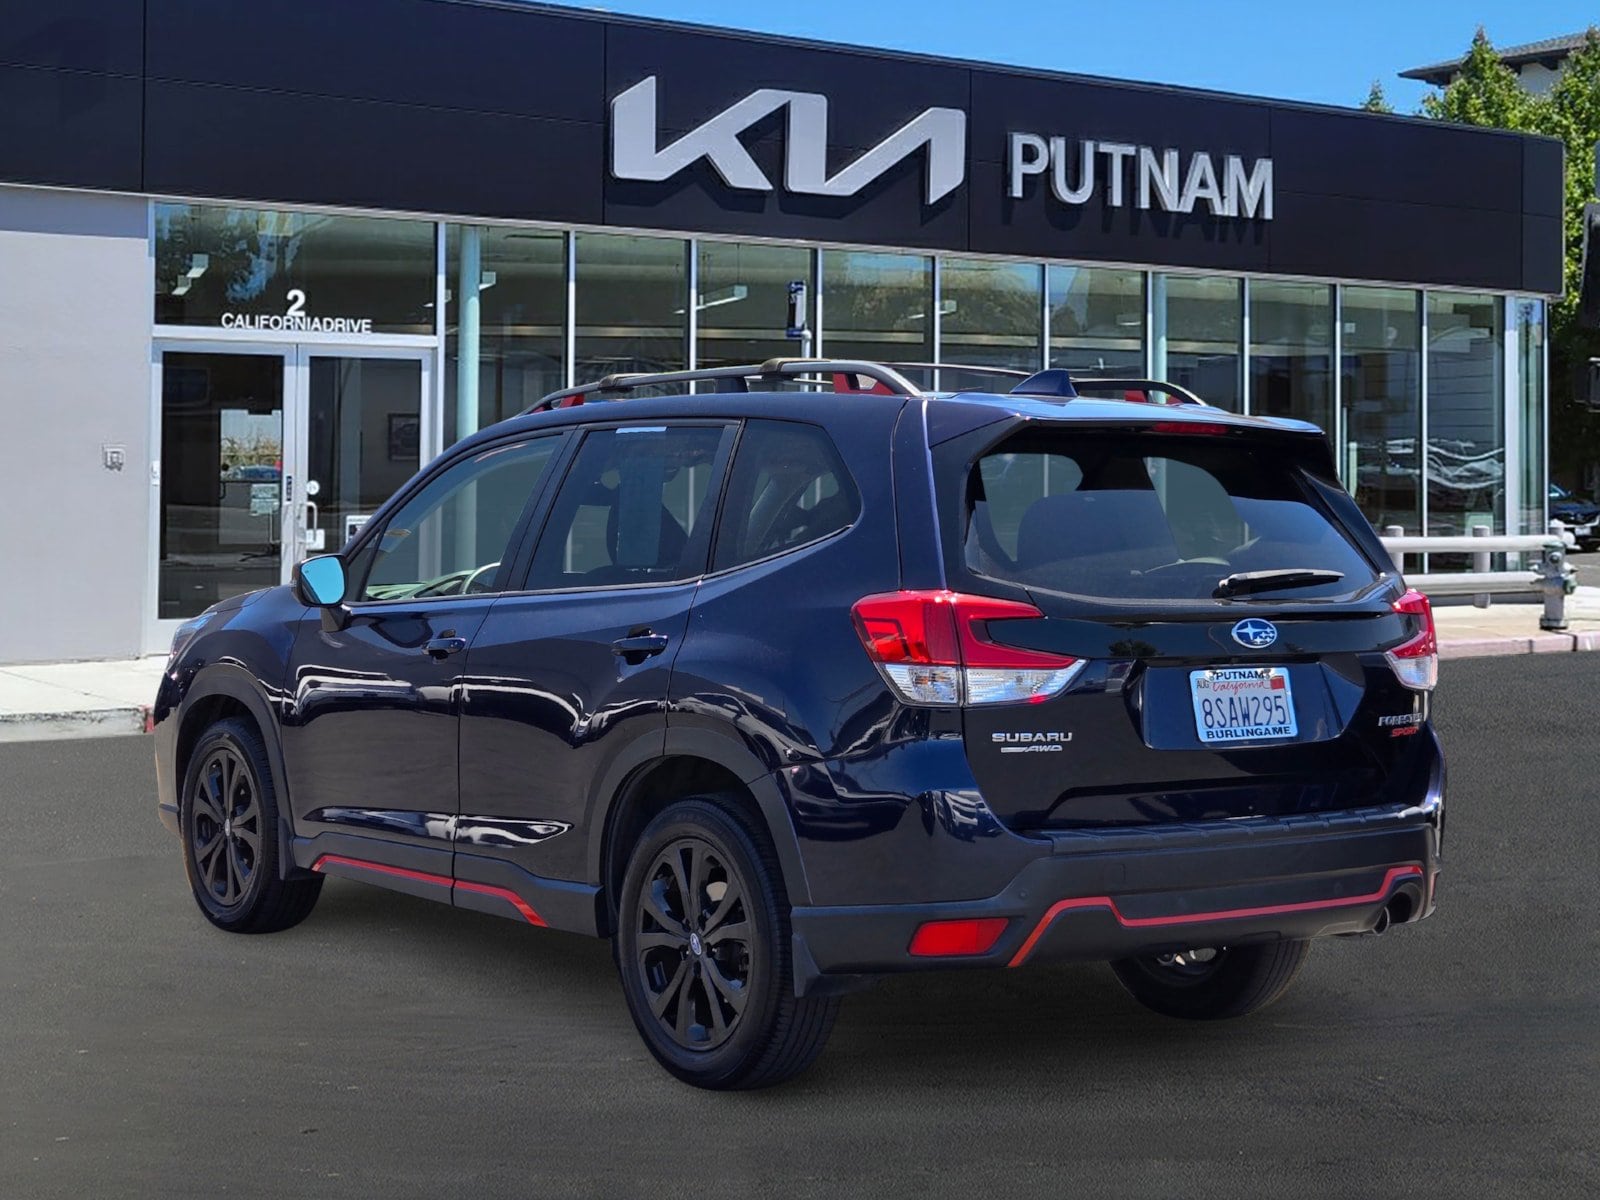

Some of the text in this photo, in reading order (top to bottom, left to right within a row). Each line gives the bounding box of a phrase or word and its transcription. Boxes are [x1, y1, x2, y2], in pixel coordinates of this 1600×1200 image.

[1008, 132, 1273, 220] PUTNAM
[286, 289, 306, 316] 2
[1215, 670, 1264, 680] PUTNAM
[1212, 681, 1266, 695] California
[1202, 696, 1287, 729] 8SAW295
[991, 732, 1073, 742] SUBARU
[1206, 726, 1291, 739] BURLINGAME
